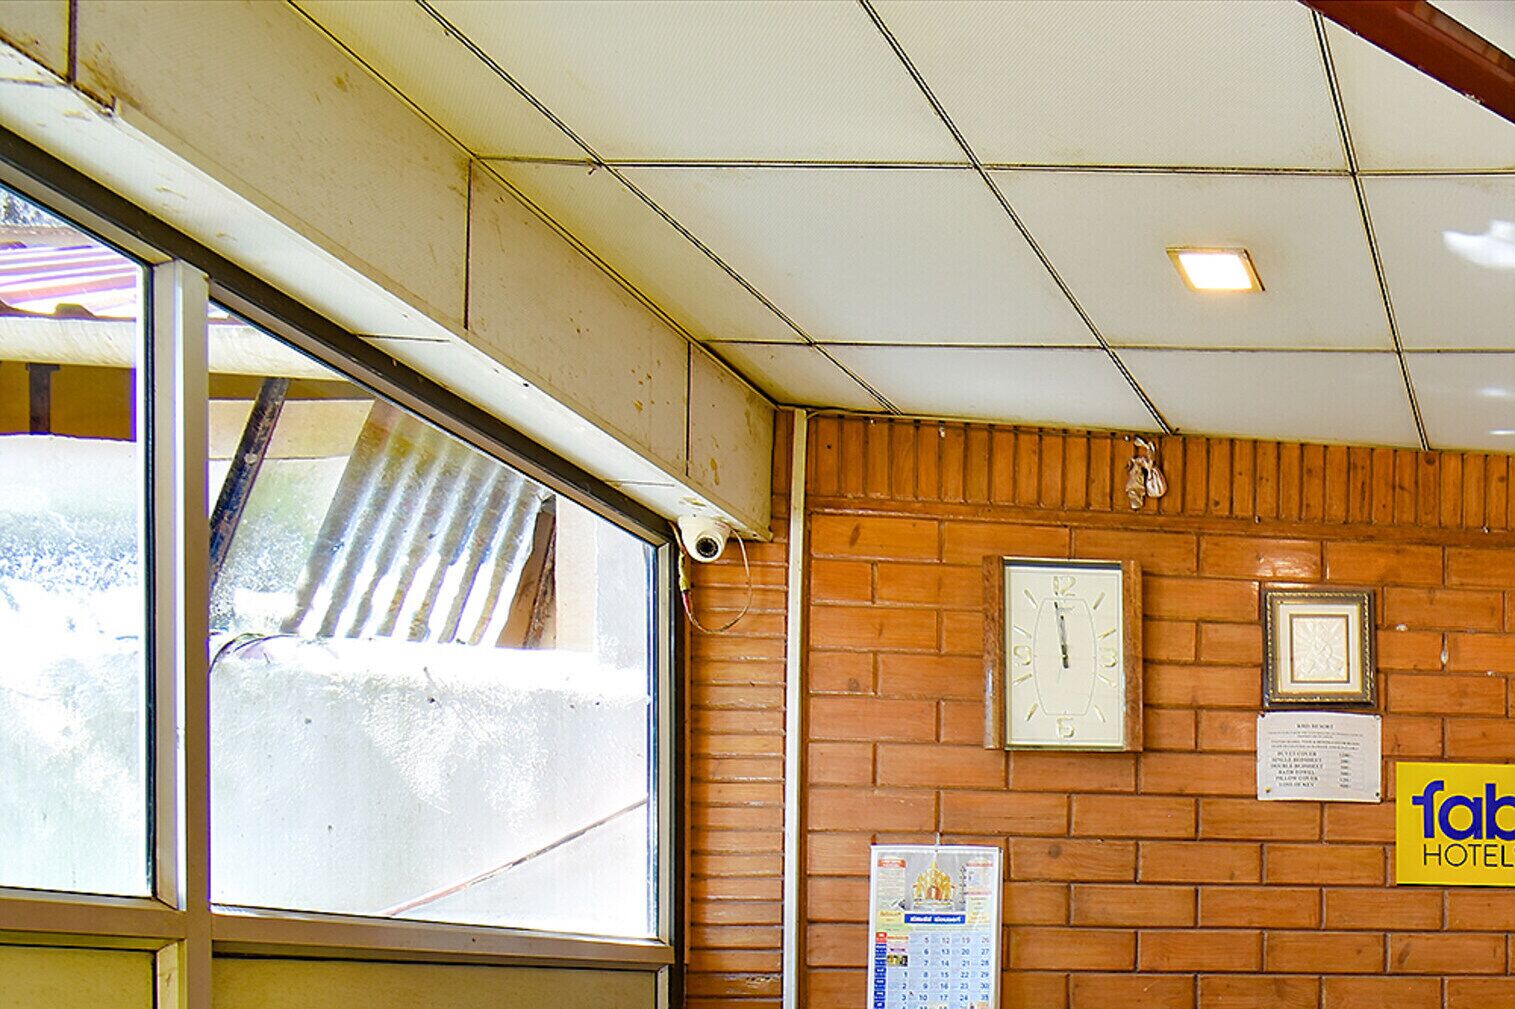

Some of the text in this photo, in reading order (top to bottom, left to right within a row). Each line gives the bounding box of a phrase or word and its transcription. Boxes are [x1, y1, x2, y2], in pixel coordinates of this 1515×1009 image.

[1053, 576, 1076, 597] 12
[1013, 645, 1118, 668] 9 3
